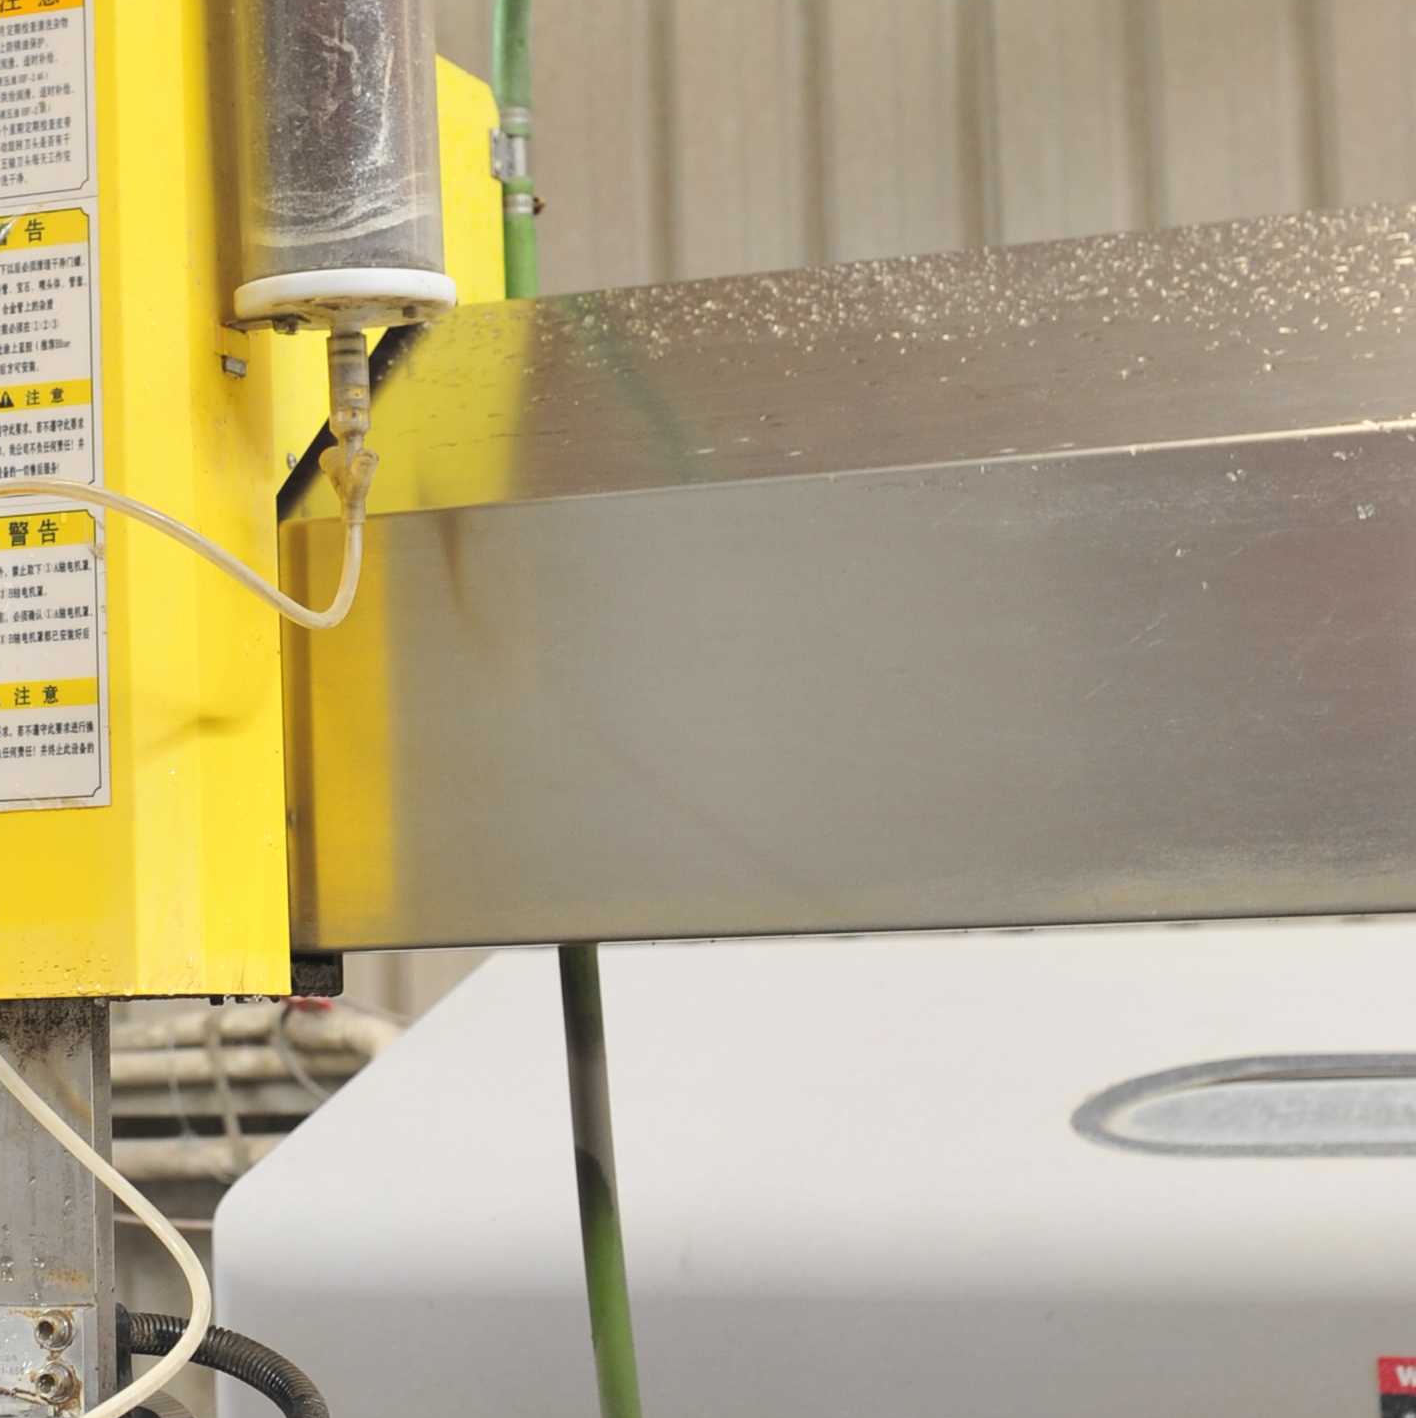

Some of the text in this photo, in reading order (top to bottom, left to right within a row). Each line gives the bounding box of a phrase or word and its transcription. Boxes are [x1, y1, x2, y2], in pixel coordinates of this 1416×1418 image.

[26, 387, 65, 406] 注意
[9, 518, 59, 547] 警告
[14, 684, 59, 706] 注意
